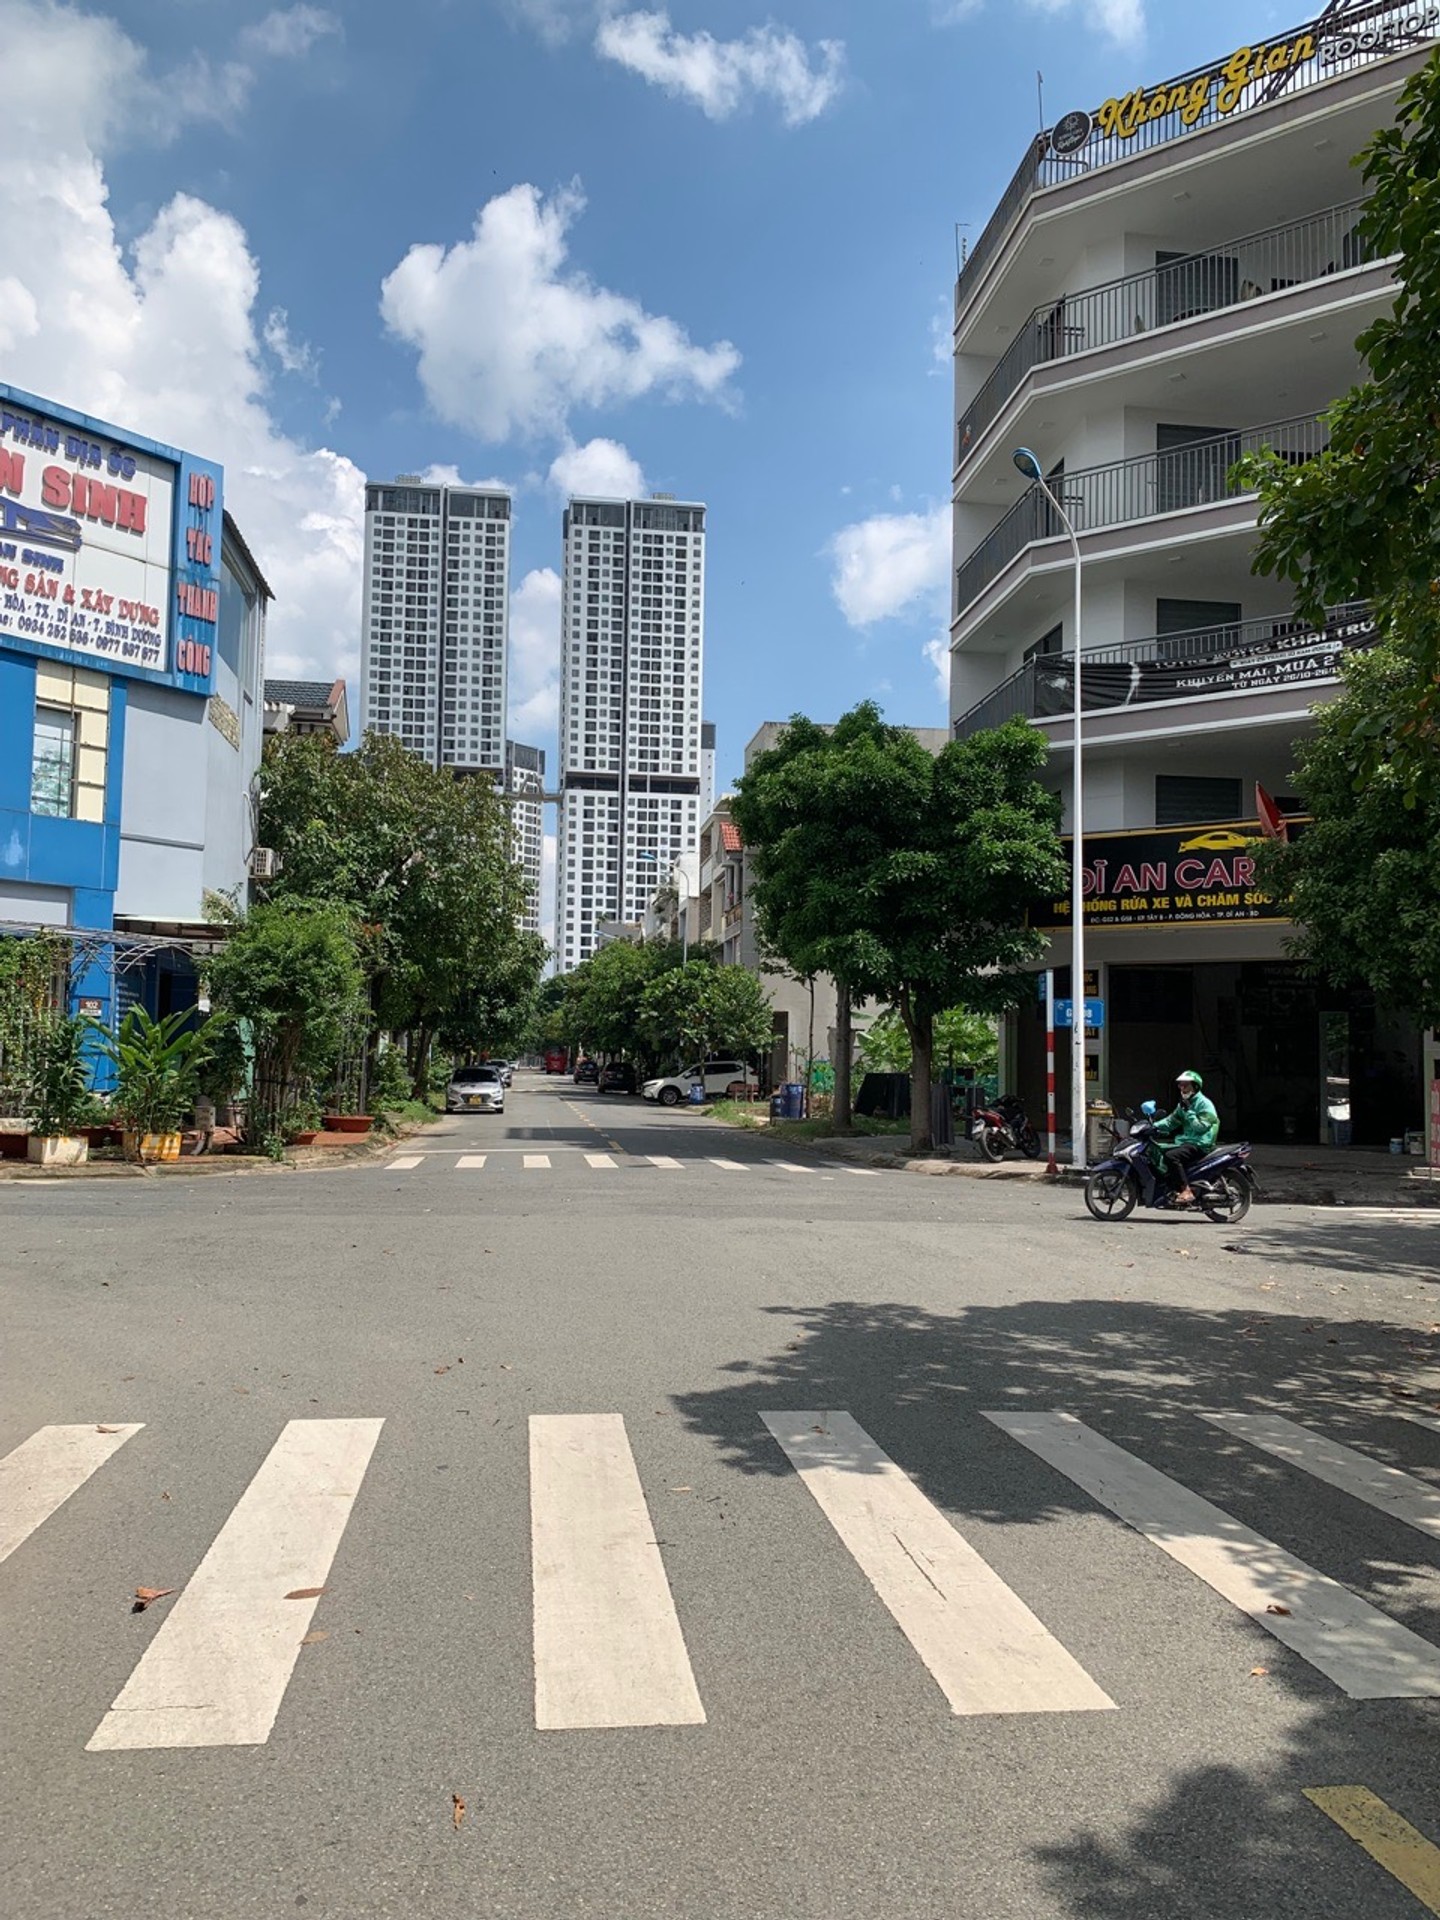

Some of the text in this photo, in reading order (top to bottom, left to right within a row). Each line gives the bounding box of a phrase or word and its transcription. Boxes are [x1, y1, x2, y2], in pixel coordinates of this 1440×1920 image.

[1321, 6, 1439, 67] ROOFTOP
[1098, 34, 1316, 138] Không Gian
[42, 465, 147, 533] SINH
[1277, 632, 1328, 650] KHAI
[1275, 659, 1318, 674] MUA
[1112, 862, 1166, 893] AN
[1174, 857, 1256, 889] CAR
[1082, 897, 1117, 911] HỐNG
[1152, 897, 1170, 909] XE
[1175, 892, 1193, 907] VÀ
[1197, 892, 1239, 907] CHĂM
